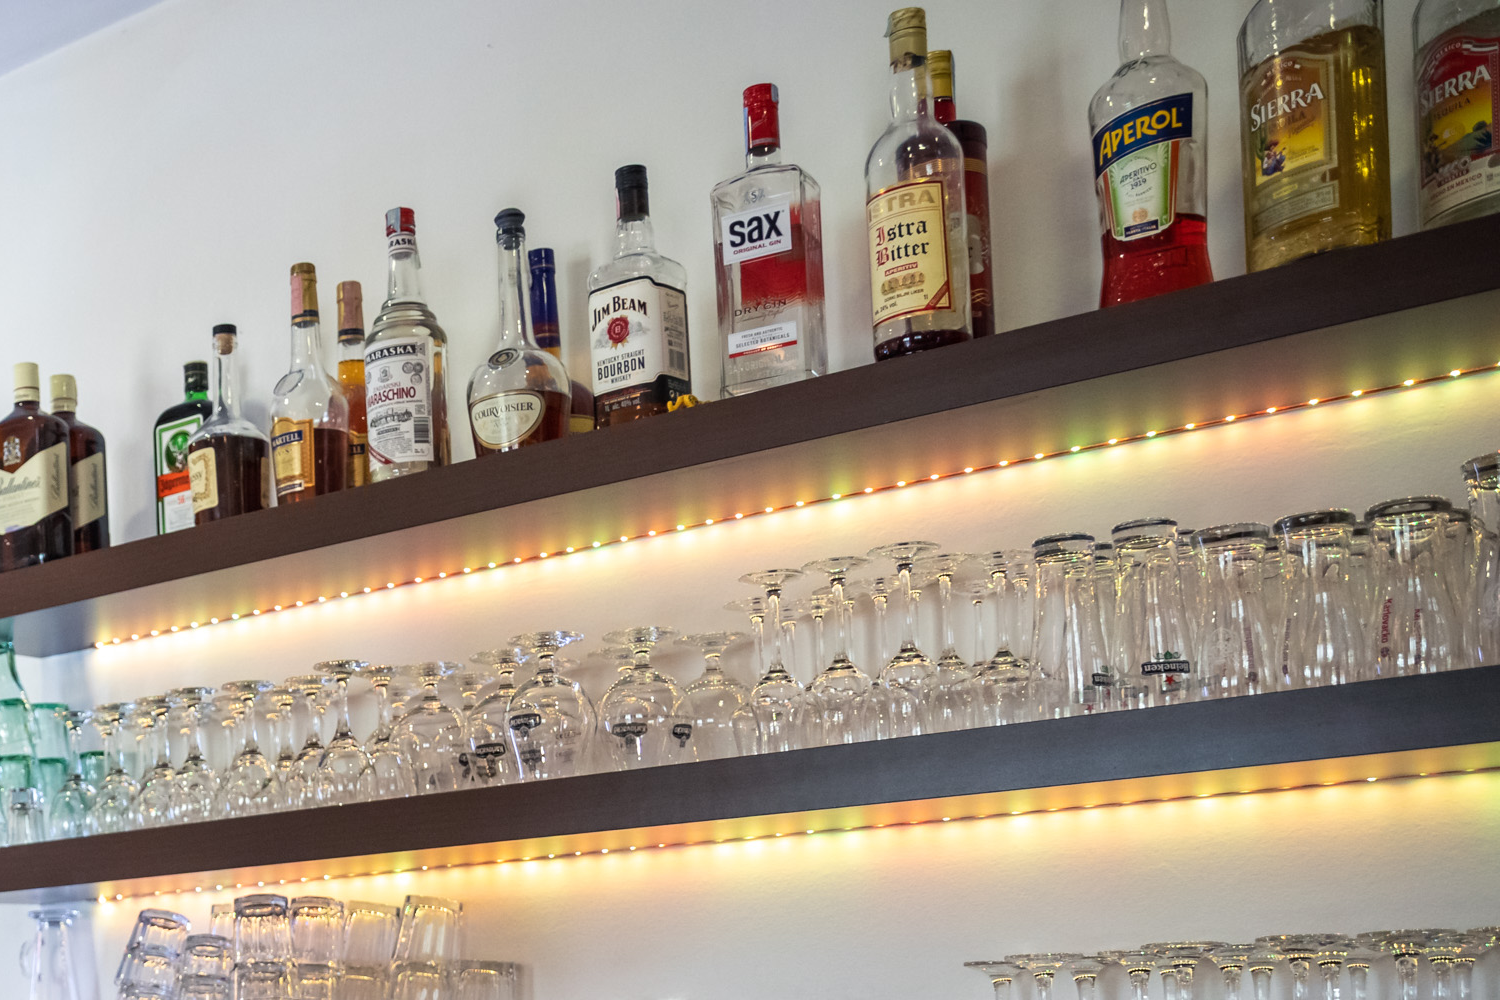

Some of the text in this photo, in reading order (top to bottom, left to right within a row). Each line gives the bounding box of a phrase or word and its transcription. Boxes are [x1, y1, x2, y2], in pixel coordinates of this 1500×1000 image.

[1419, 65, 1491, 116] SIERRA
[1251, 83, 1324, 132] SIERRA
[1100, 107, 1182, 166] APEROL
[1120, 162, 1157, 184] APERITIVO
[1131, 178, 1147, 190] 1919
[729, 211, 783, 248] sax
[876, 220, 928, 247] Istra
[733, 243, 767, 255] ORIGINAL
[876, 241, 929, 270] Bitter
[592, 295, 648, 332] JIM BEAM
[734, 300, 787, 317] DRY GIN
[597, 349, 645, 367] KENTUCKY STRAIGHT
[597, 356, 645, 380] BOURBON
[611, 374, 631, 384] WHISKEY
[474, 401, 534, 422] COURVOISIER
